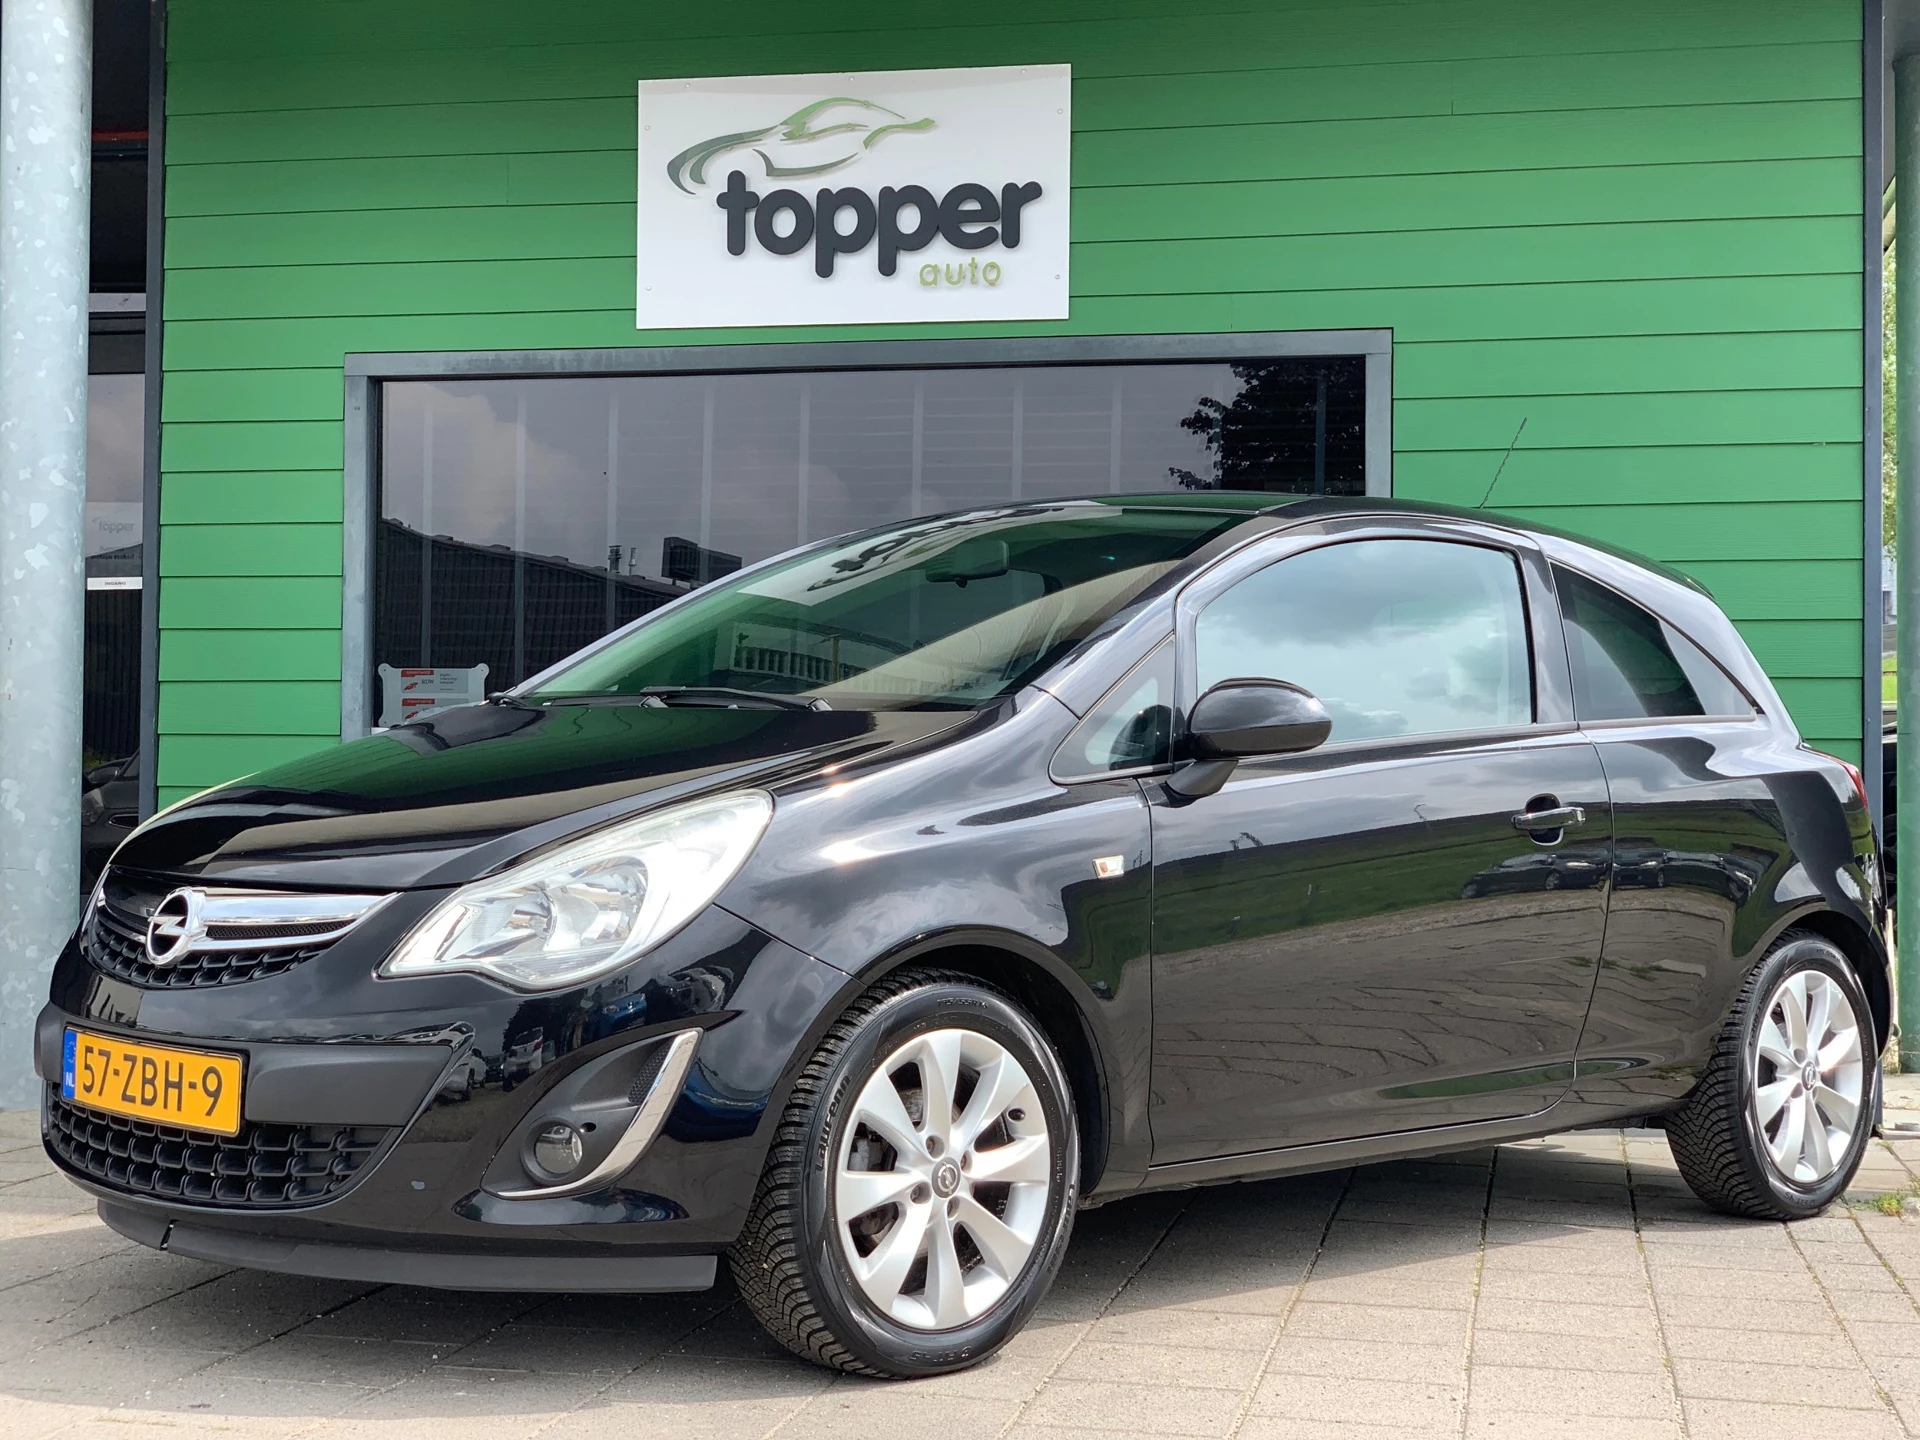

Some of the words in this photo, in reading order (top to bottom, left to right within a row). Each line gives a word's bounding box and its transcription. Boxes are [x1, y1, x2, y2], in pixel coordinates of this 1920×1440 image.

[716, 170, 1043, 278] topper
[919, 257, 1002, 287] auto
[65, 1071, 75, 1088] NL
[82, 1045, 223, 1117] 57-ZBH-9
